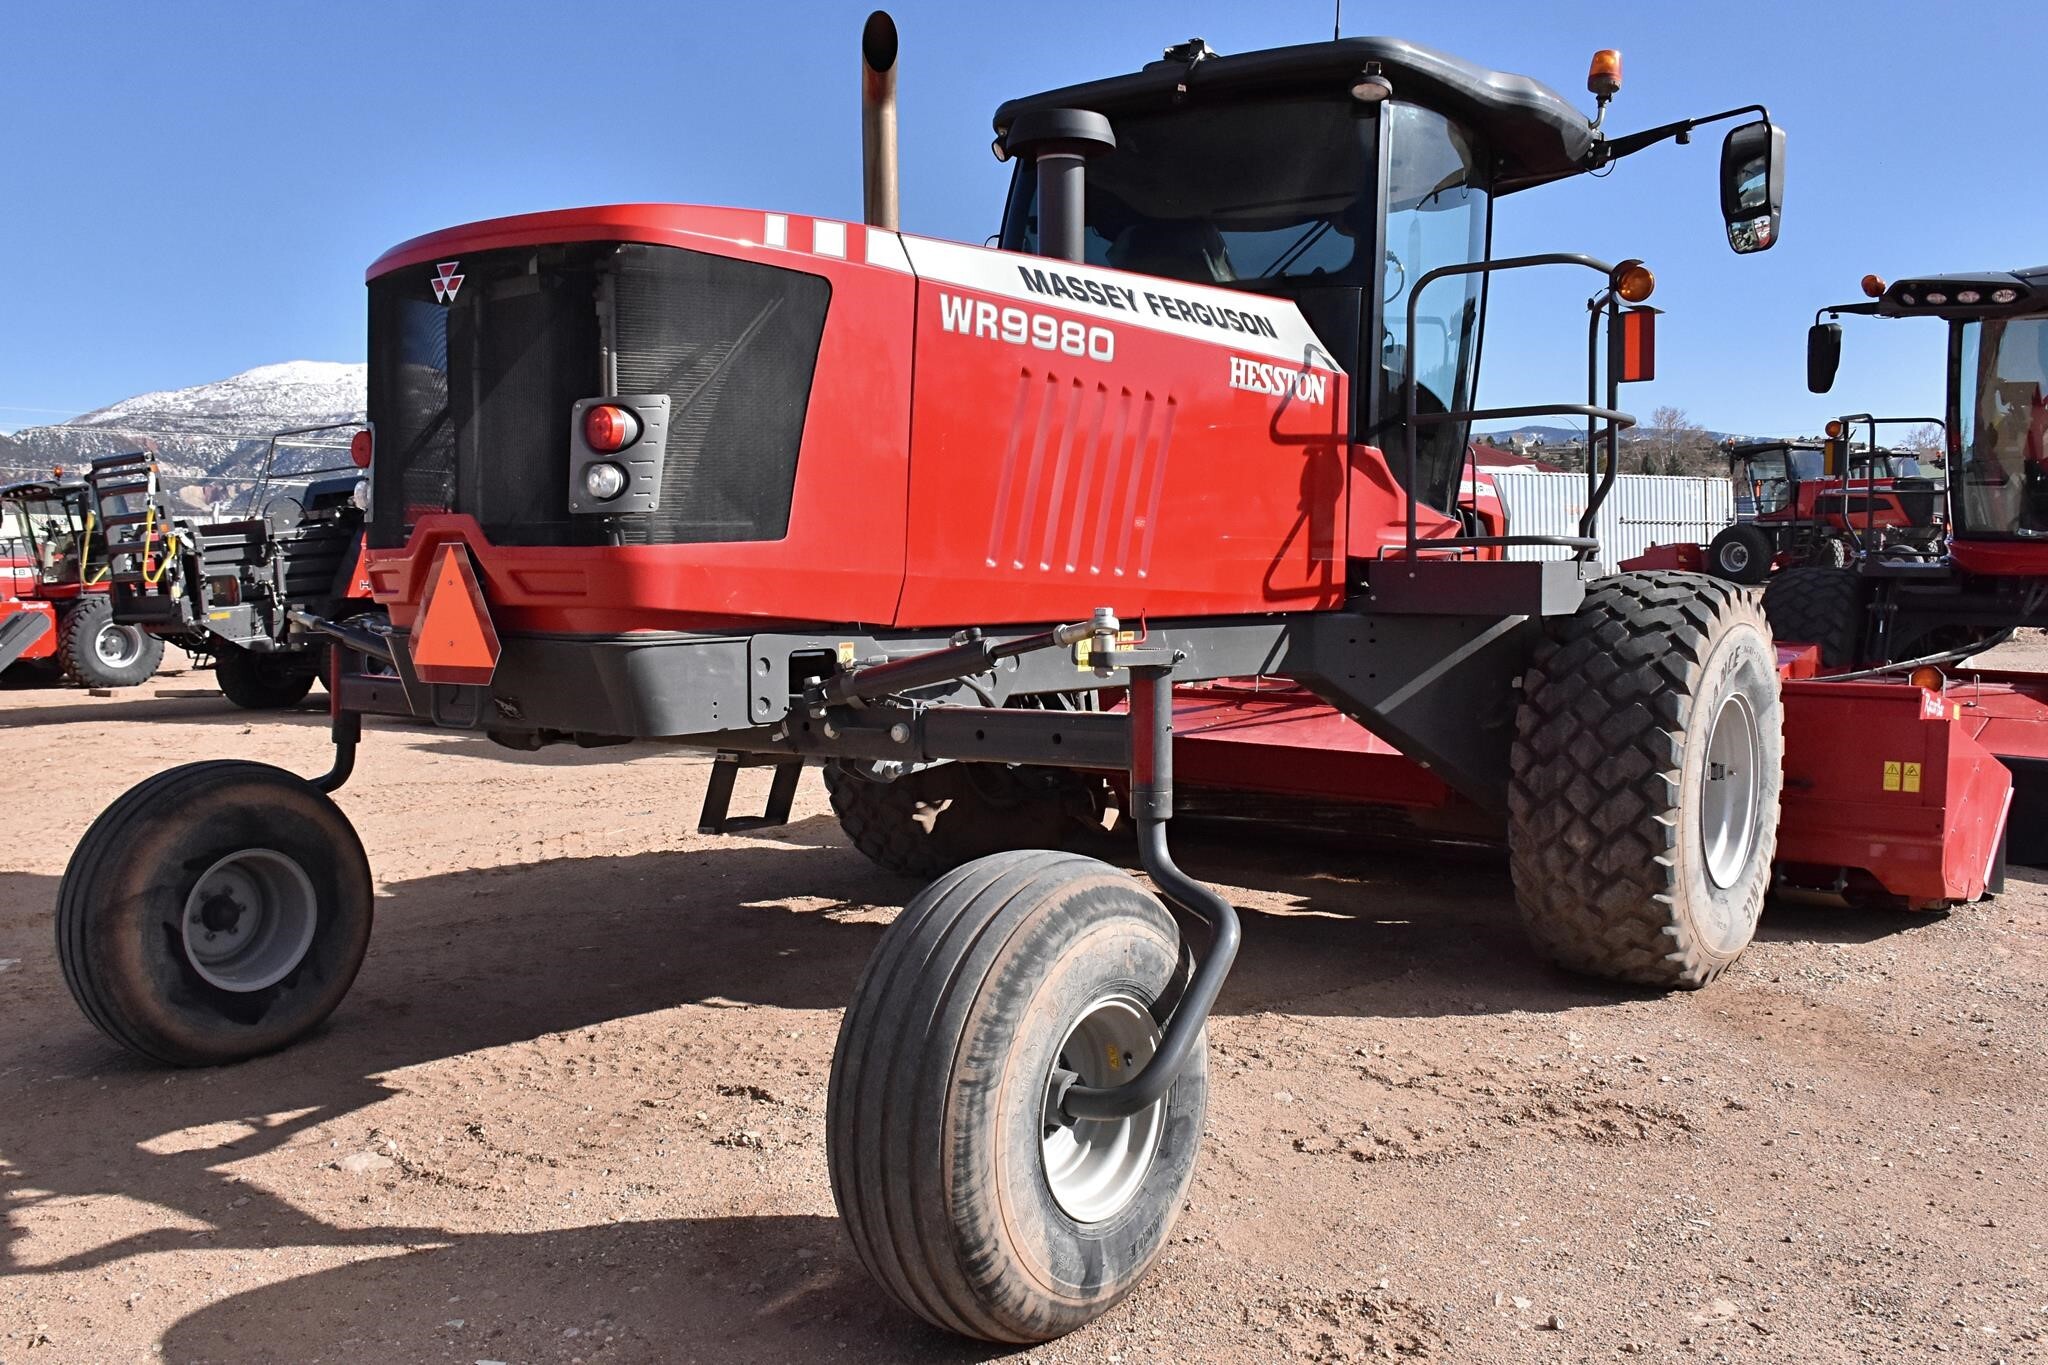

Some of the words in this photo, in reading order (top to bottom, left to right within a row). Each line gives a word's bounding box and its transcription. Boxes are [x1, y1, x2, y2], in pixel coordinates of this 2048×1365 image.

[939, 293, 1116, 363] WR9980
[1018, 266, 1139, 313] MASSEY
[1143, 292, 1279, 339] FERGUSON
[1229, 356, 1327, 406] HESSTON
